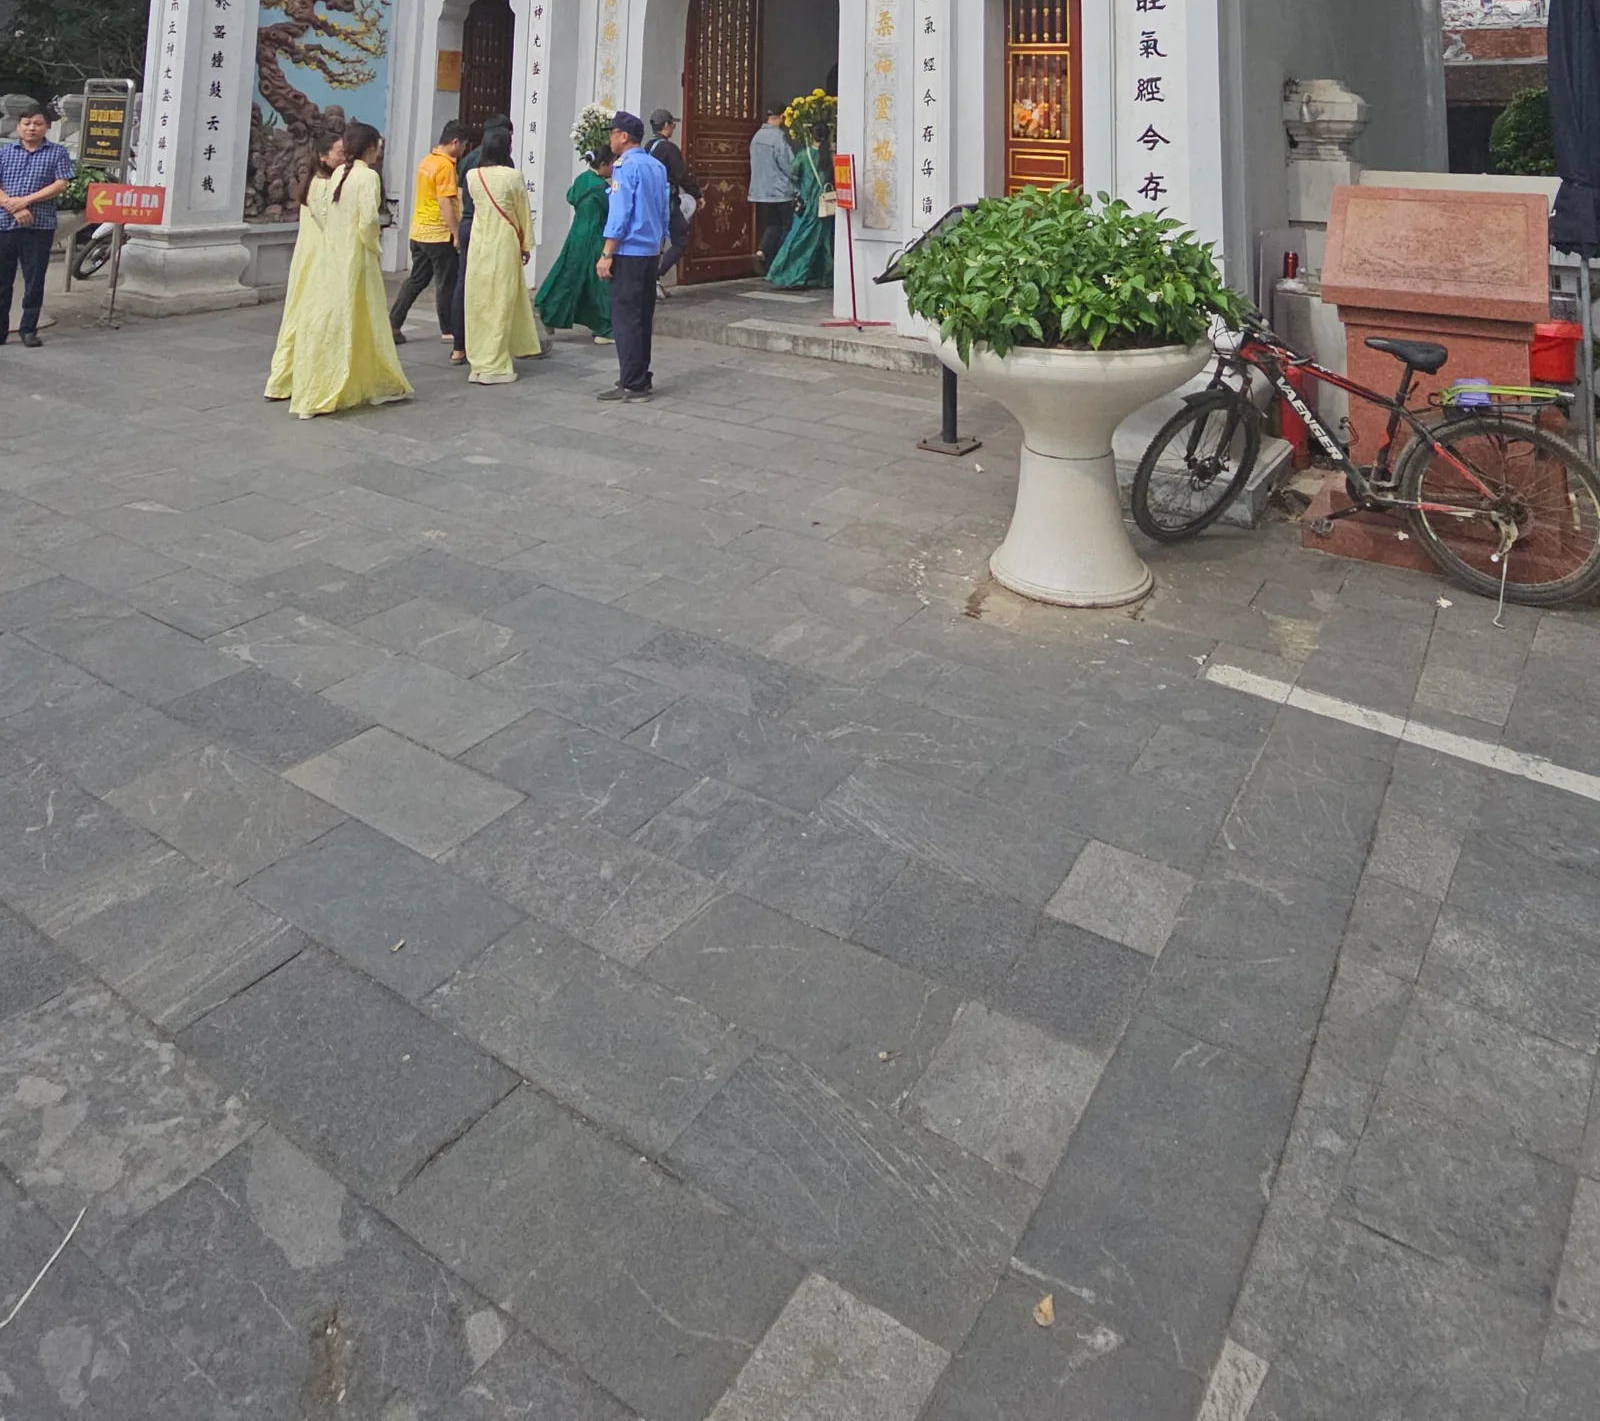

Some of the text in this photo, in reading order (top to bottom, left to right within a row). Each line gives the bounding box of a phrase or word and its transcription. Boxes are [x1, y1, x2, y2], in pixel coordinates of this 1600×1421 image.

[115, 189, 159, 208] LỐI RA
[122, 208, 153, 217] EXIT
[1276, 375, 1344, 460] VAENGER
